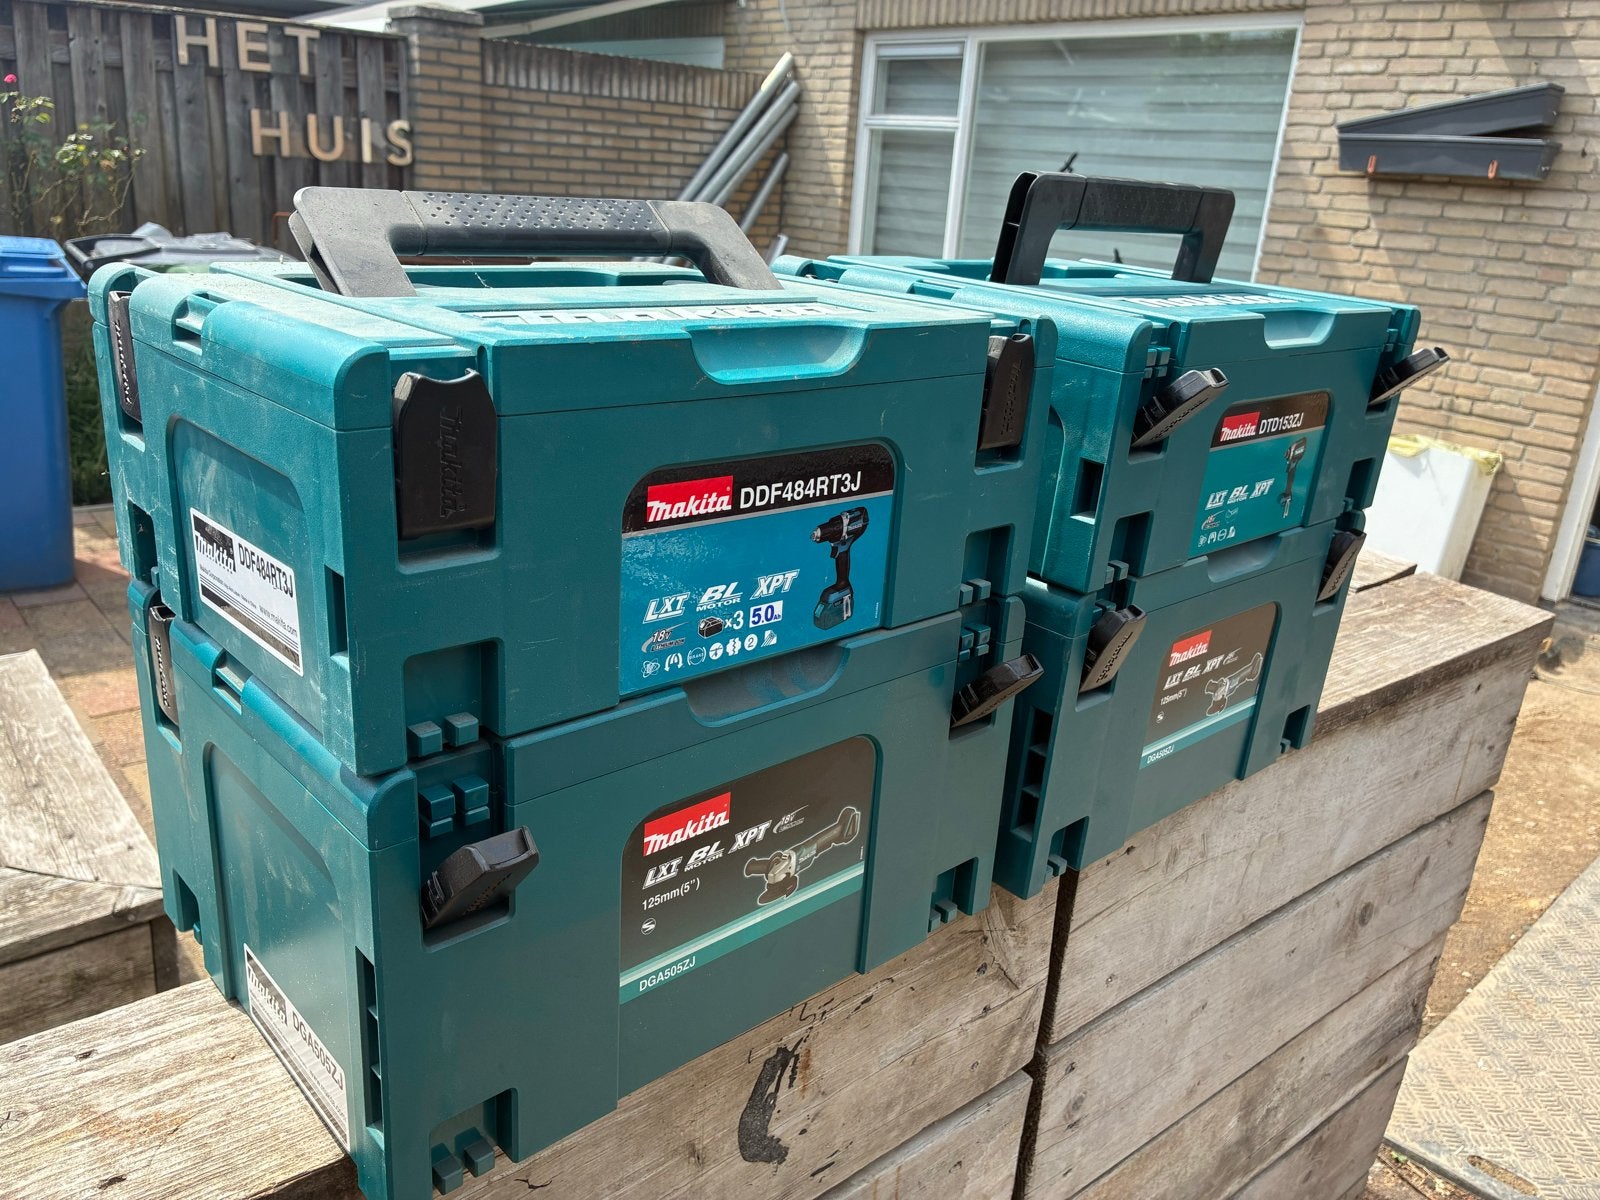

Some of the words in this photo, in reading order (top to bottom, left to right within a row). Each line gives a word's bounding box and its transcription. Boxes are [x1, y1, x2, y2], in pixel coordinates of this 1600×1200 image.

[175, 15, 320, 75] HET
[251, 108, 412, 166] HUIS
[1259, 413, 1304, 434] DTD153ZJ
[740, 471, 861, 509] DDF484RT3J
[1205, 490, 1228, 510] LXT
[1249, 478, 1275, 498] XPT
[238, 543, 294, 598] DDF484RT3J
[643, 592, 690, 624] LXT
[700, 582, 743, 602] BL
[750, 569, 800, 600] XPT
[696, 598, 741, 612] MOTOR
[724, 610, 744, 630] x3
[643, 857, 682, 889] LXT
[687, 841, 724, 864] BL
[728, 820, 772, 854] XPT
[685, 854, 724, 872] MOTOR
[639, 956, 696, 991] DGA505ZJ
[292, 1011, 344, 1090] DGA505ZJ
